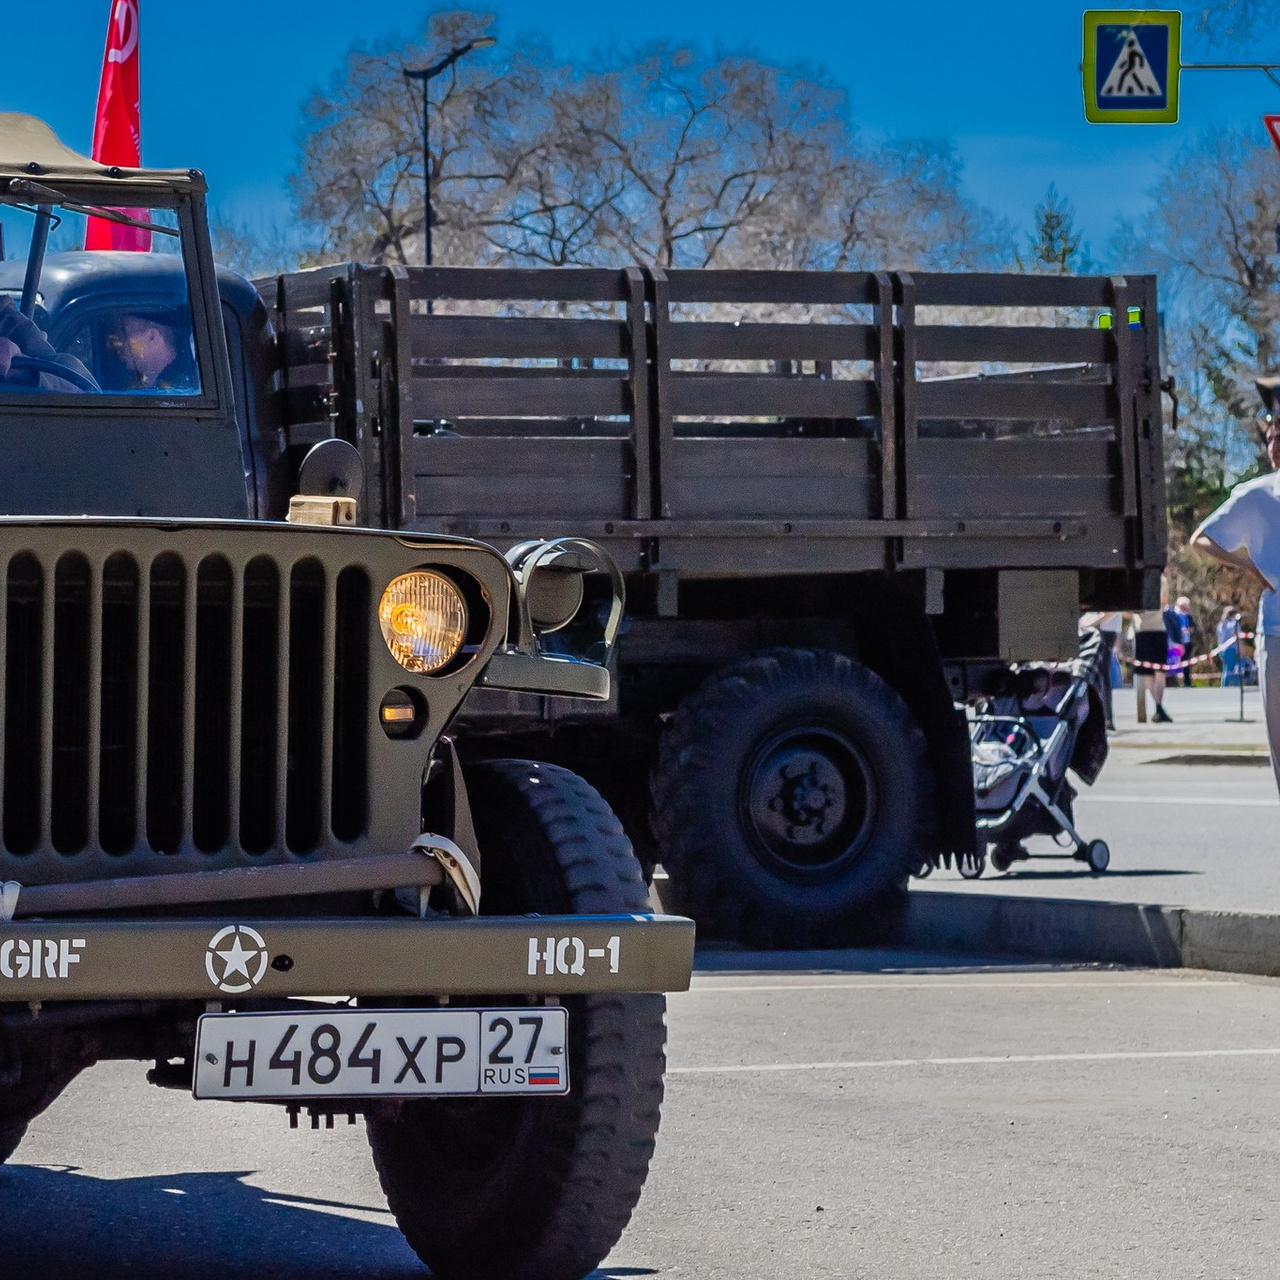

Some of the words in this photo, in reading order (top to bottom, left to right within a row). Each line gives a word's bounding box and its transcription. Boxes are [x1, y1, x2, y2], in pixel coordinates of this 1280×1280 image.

[527, 936, 620, 976] HQ-1
[223, 1022, 467, 1088] Н484ХР
[488, 1017, 544, 1065] 27
[483, 1067, 527, 1086] RUS
